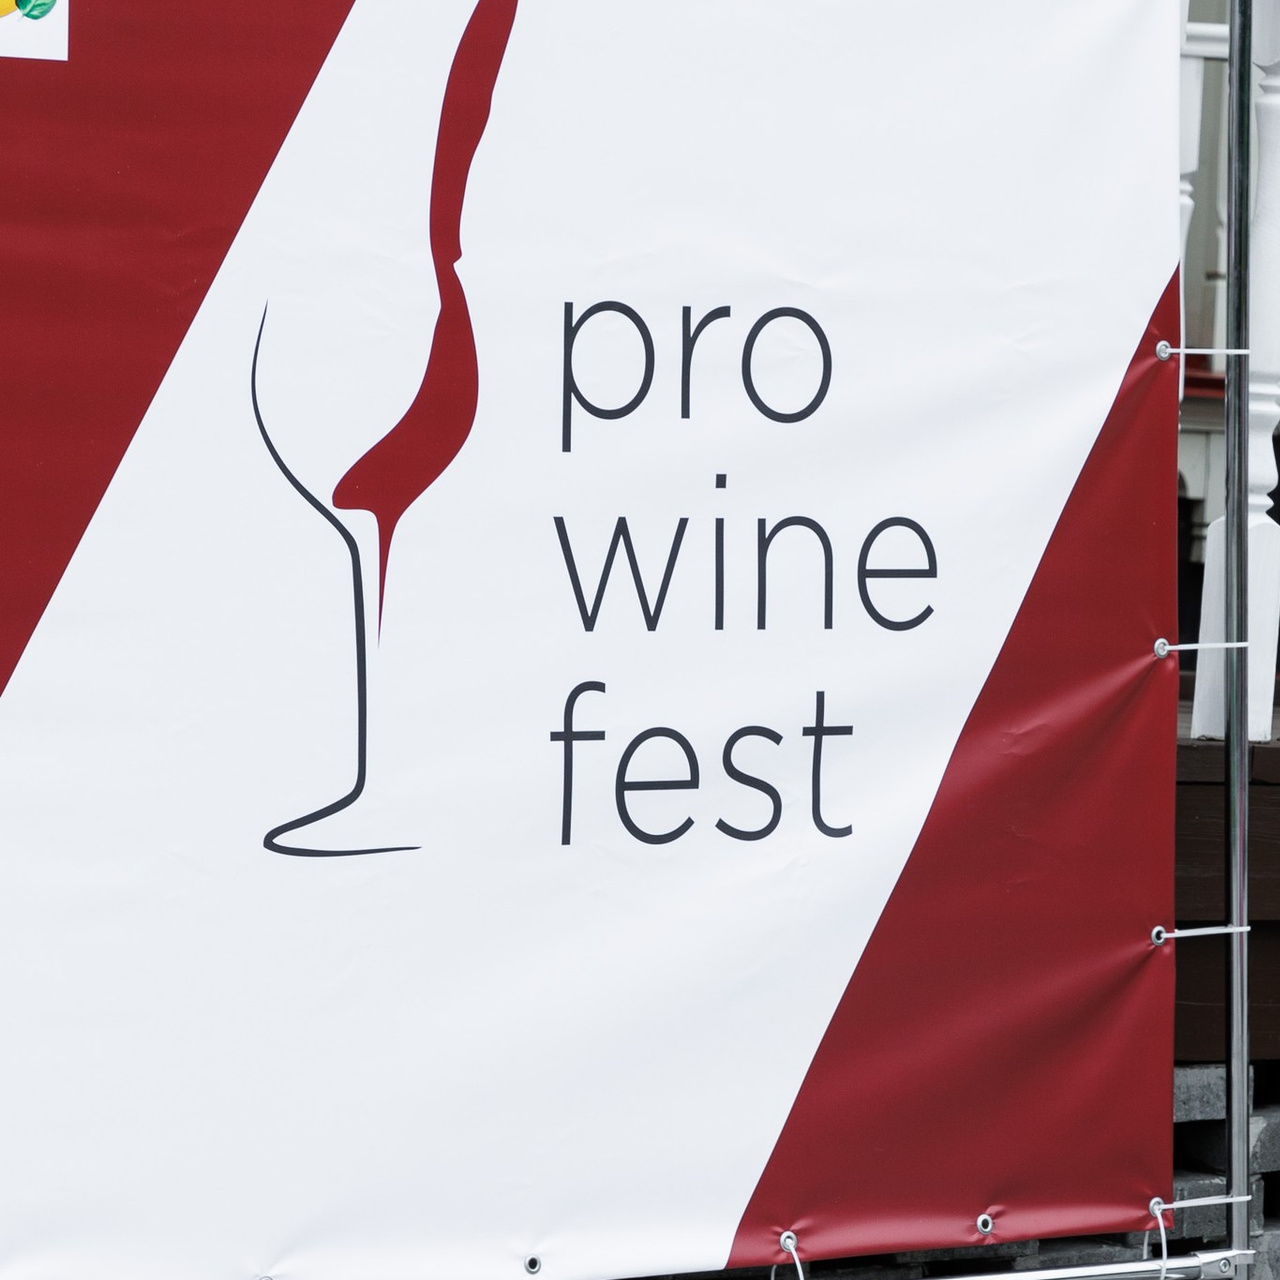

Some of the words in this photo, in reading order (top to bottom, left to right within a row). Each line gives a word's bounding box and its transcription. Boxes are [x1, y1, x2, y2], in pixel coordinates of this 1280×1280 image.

[562, 300, 832, 453] pro
[553, 473, 938, 632] wine
[550, 680, 854, 846] fest
